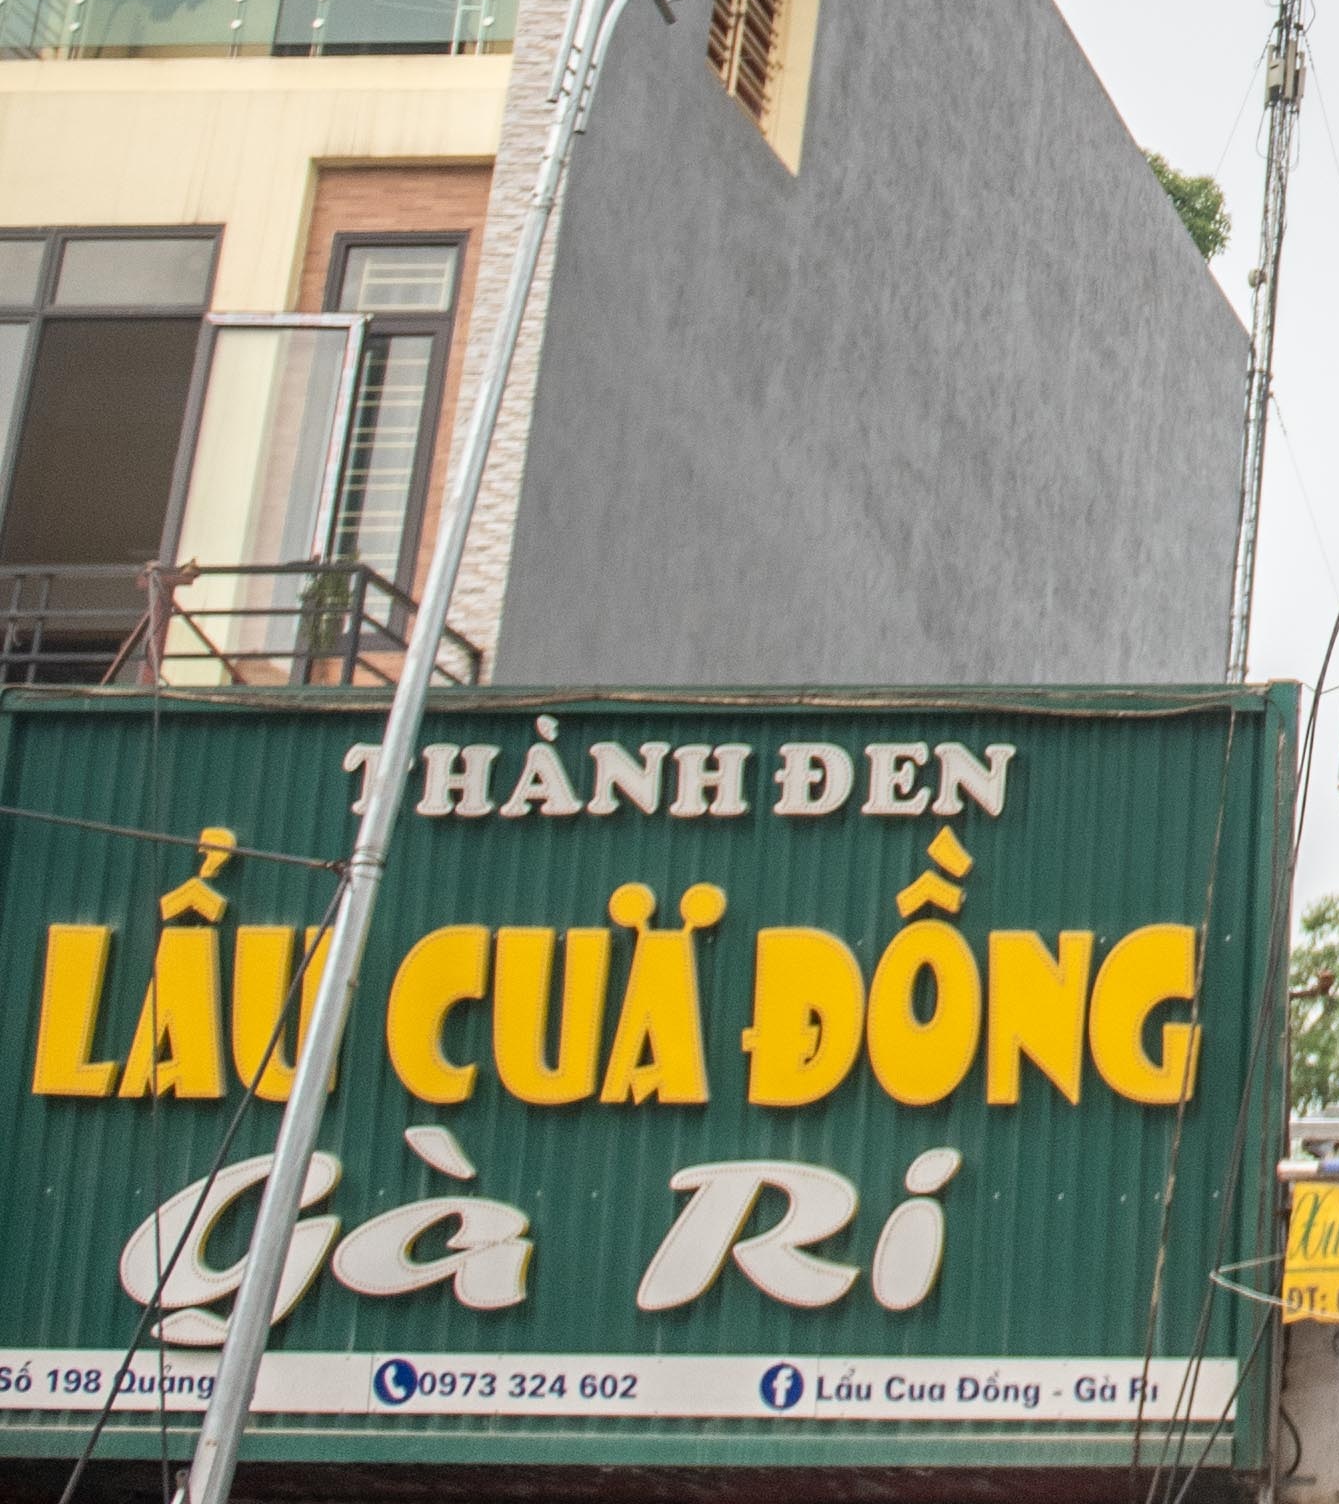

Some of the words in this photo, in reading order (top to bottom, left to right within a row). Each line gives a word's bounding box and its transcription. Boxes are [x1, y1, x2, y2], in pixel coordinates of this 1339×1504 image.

[341, 714, 752, 817] THÀNH
[772, 741, 1017, 818] ĐEN
[32, 827, 339, 1102] LẨU
[387, 882, 728, 1107] CUA
[741, 826, 1203, 1107] ĐỒNG
[119, 1125, 534, 1346] Gà
[0, 1360, 32, 1394] Số
[47, 1368, 102, 1393] 198
[113, 1364, 216, 1400] Quảng
[418, 1370, 497, 1397] 0973
[508, 1372, 567, 1398] 324
[579, 1372, 638, 1398] 602
[816, 1369, 872, 1402] Lẩu
[885, 1376, 946, 1402] Cua
[957, 1369, 1040, 1408] Đồng
[1074, 1374, 1118, 1403] Gà
